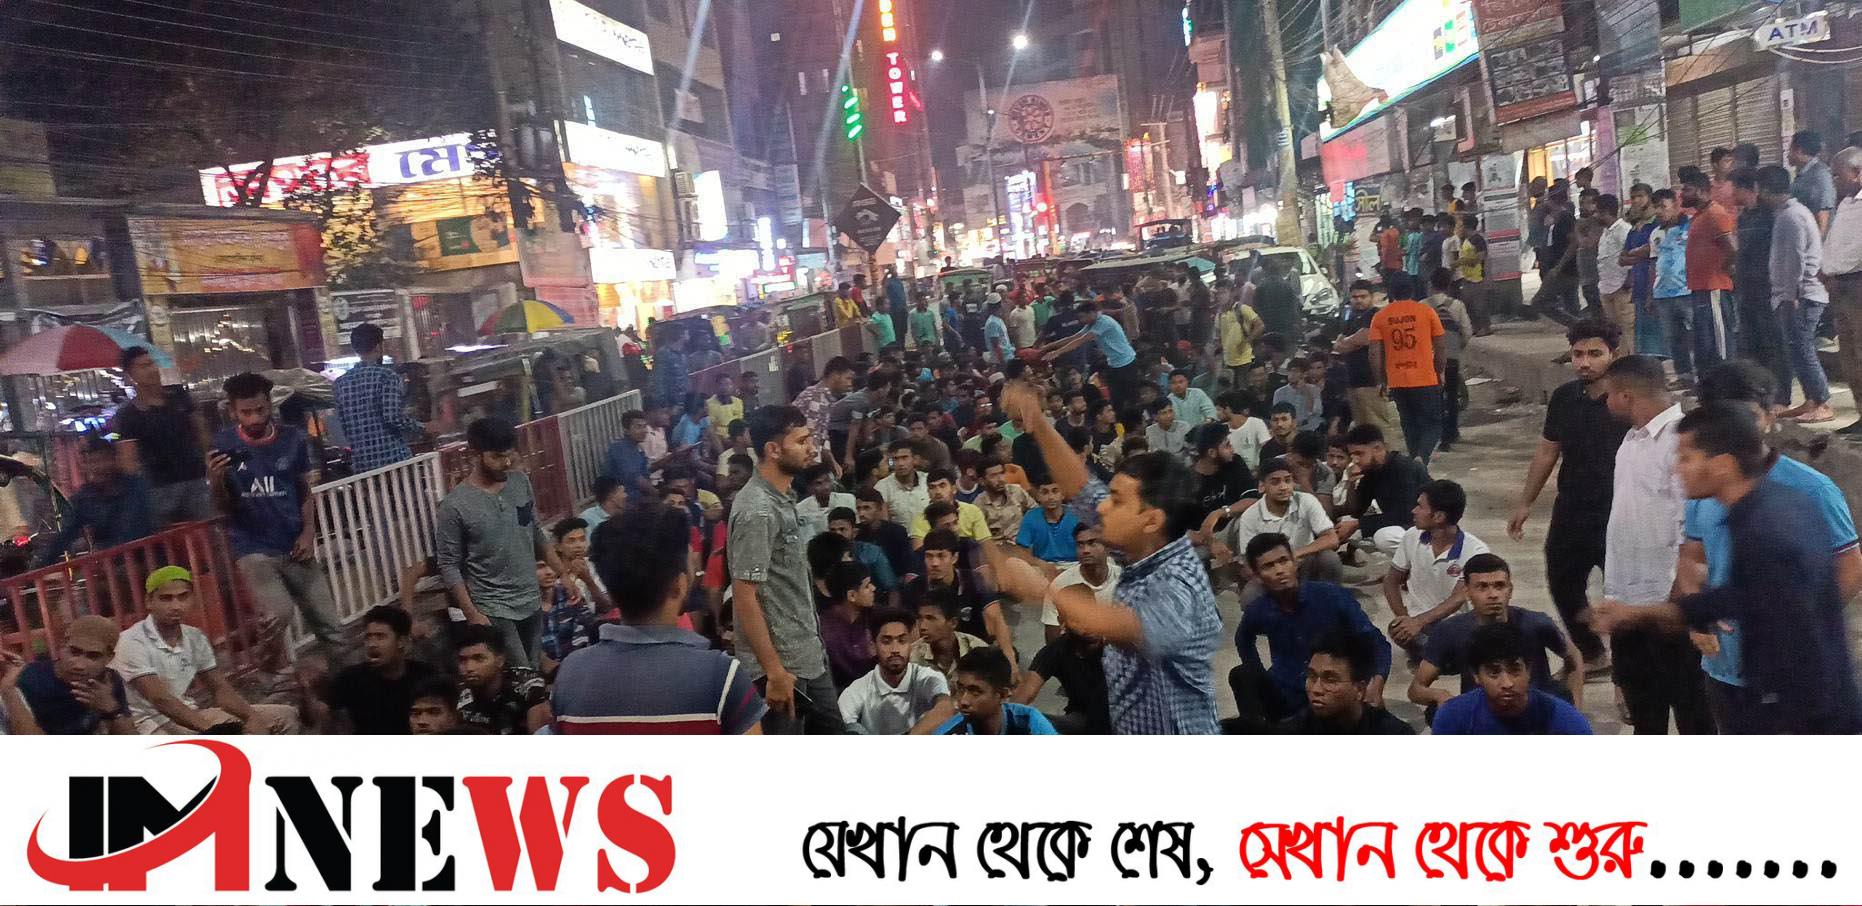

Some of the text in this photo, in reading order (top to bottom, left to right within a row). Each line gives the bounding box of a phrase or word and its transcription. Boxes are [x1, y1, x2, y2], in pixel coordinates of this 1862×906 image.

[1768, 19, 1818, 41] ATM
[886, 52, 907, 123] TOWER
[1391, 327, 1418, 351] 95
